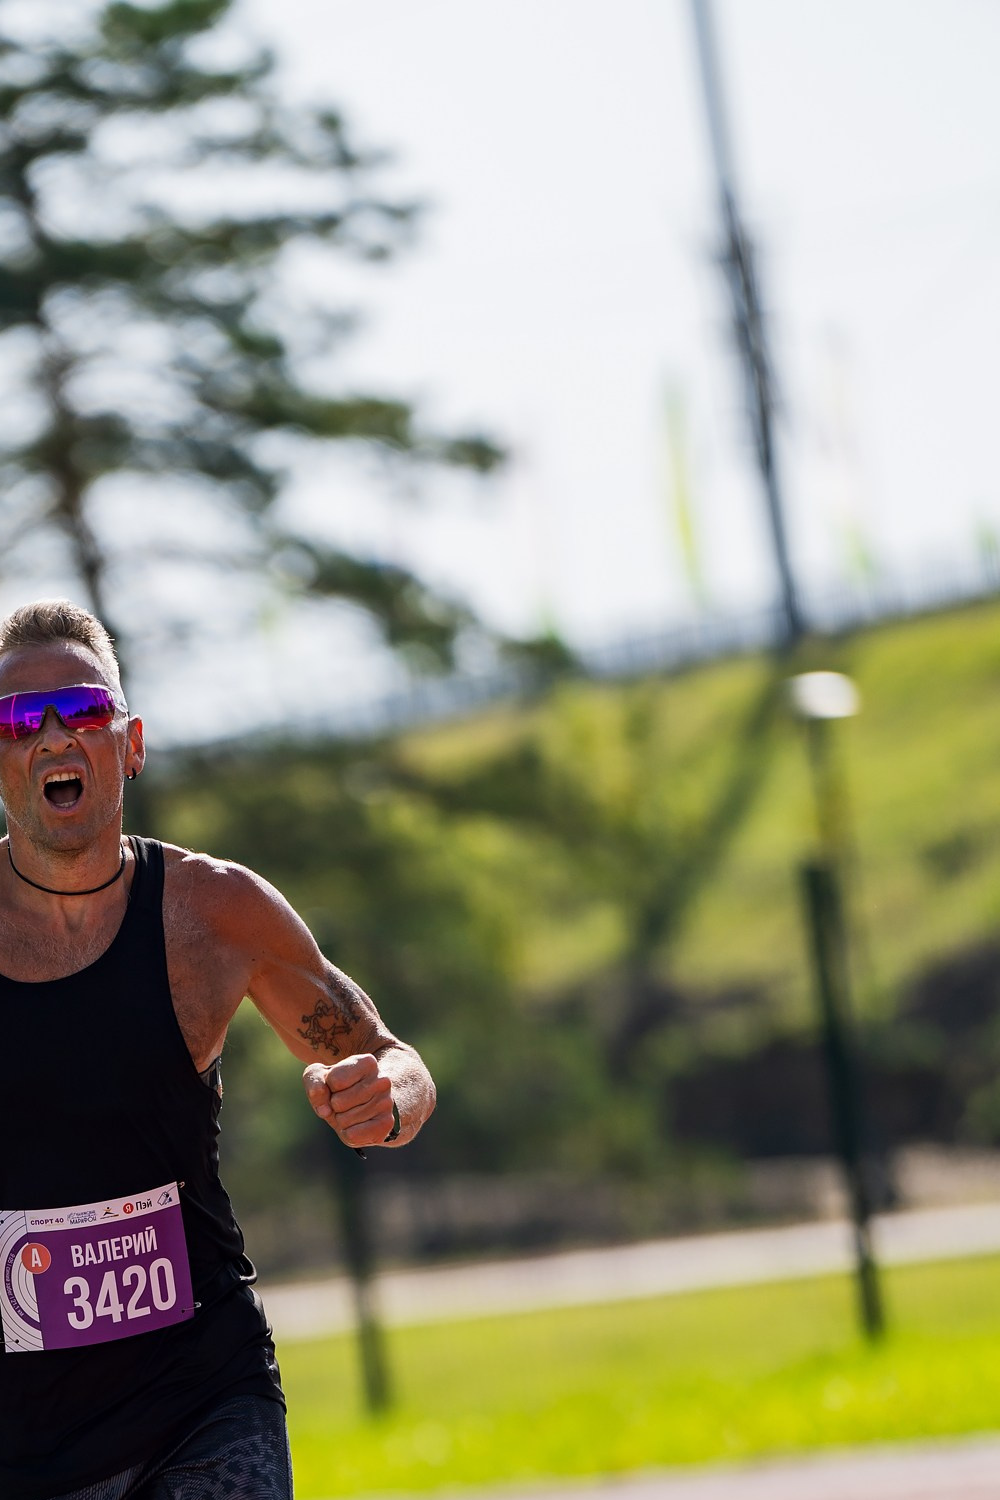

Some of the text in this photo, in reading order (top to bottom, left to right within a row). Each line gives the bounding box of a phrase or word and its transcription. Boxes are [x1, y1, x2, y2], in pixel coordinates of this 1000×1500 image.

[135, 1198, 153, 1211] Пэй
[30, 1218, 54, 1226] СПОРТ
[70, 1225, 158, 1268] ВАЛЕРИЙ
[63, 1257, 177, 1330] 3420
